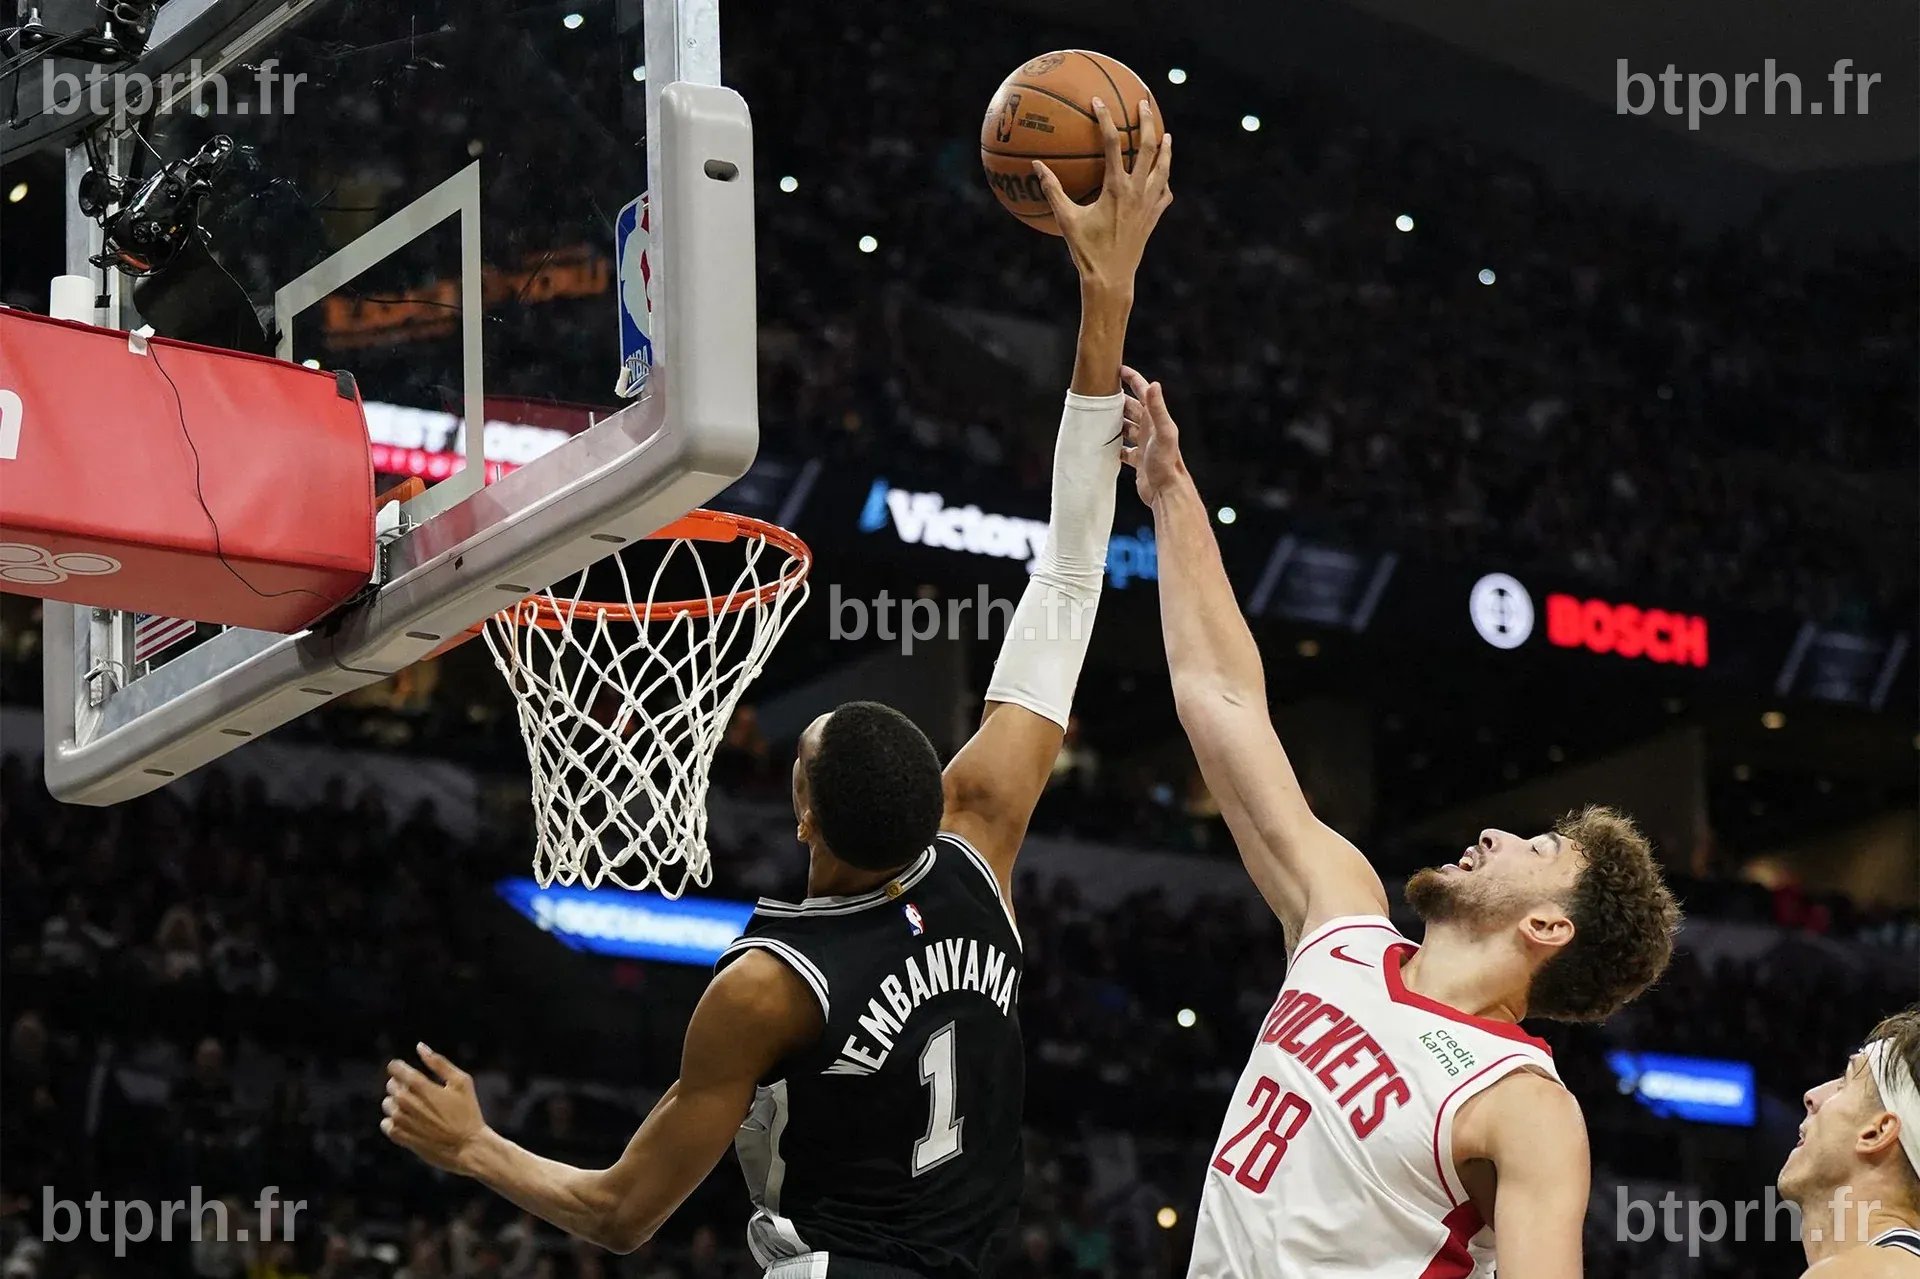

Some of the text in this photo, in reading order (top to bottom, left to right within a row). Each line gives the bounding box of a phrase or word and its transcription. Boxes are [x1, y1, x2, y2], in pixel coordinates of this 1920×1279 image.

[1545, 593, 1709, 669] BOSCH
[1418, 1031, 1461, 1077] karma
[1435, 1029, 1476, 1070] credit
[911, 1019, 966, 1179] 1
[1211, 1074, 1313, 1195] 28
